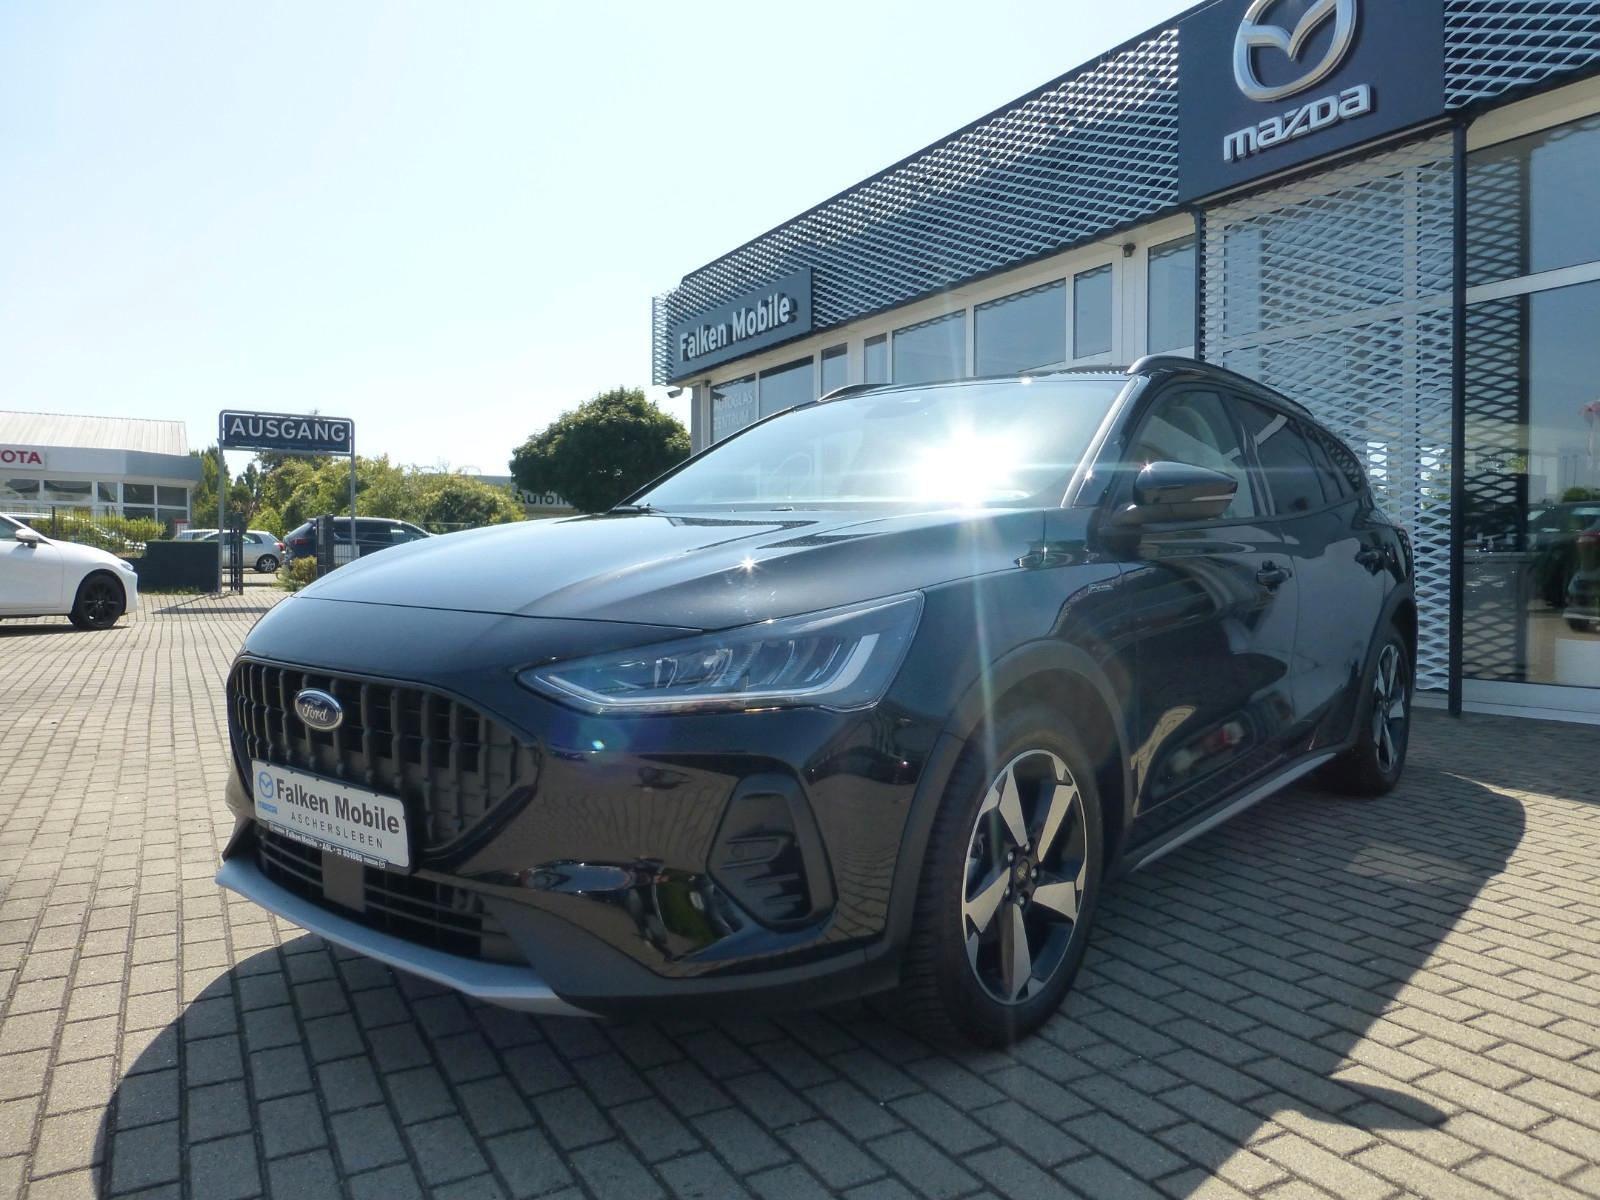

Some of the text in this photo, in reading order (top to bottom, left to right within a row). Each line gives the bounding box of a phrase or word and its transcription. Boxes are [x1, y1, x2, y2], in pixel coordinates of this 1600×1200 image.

[680, 293, 790, 361] Falken Mobile
[230, 418, 345, 441] AUSGANG
[0, 449, 42, 464] OTA
[302, 703, 329, 721] Ford
[276, 778, 400, 834] Falken Mobile
[291, 812, 383, 849] ASCHERSLEBEN
